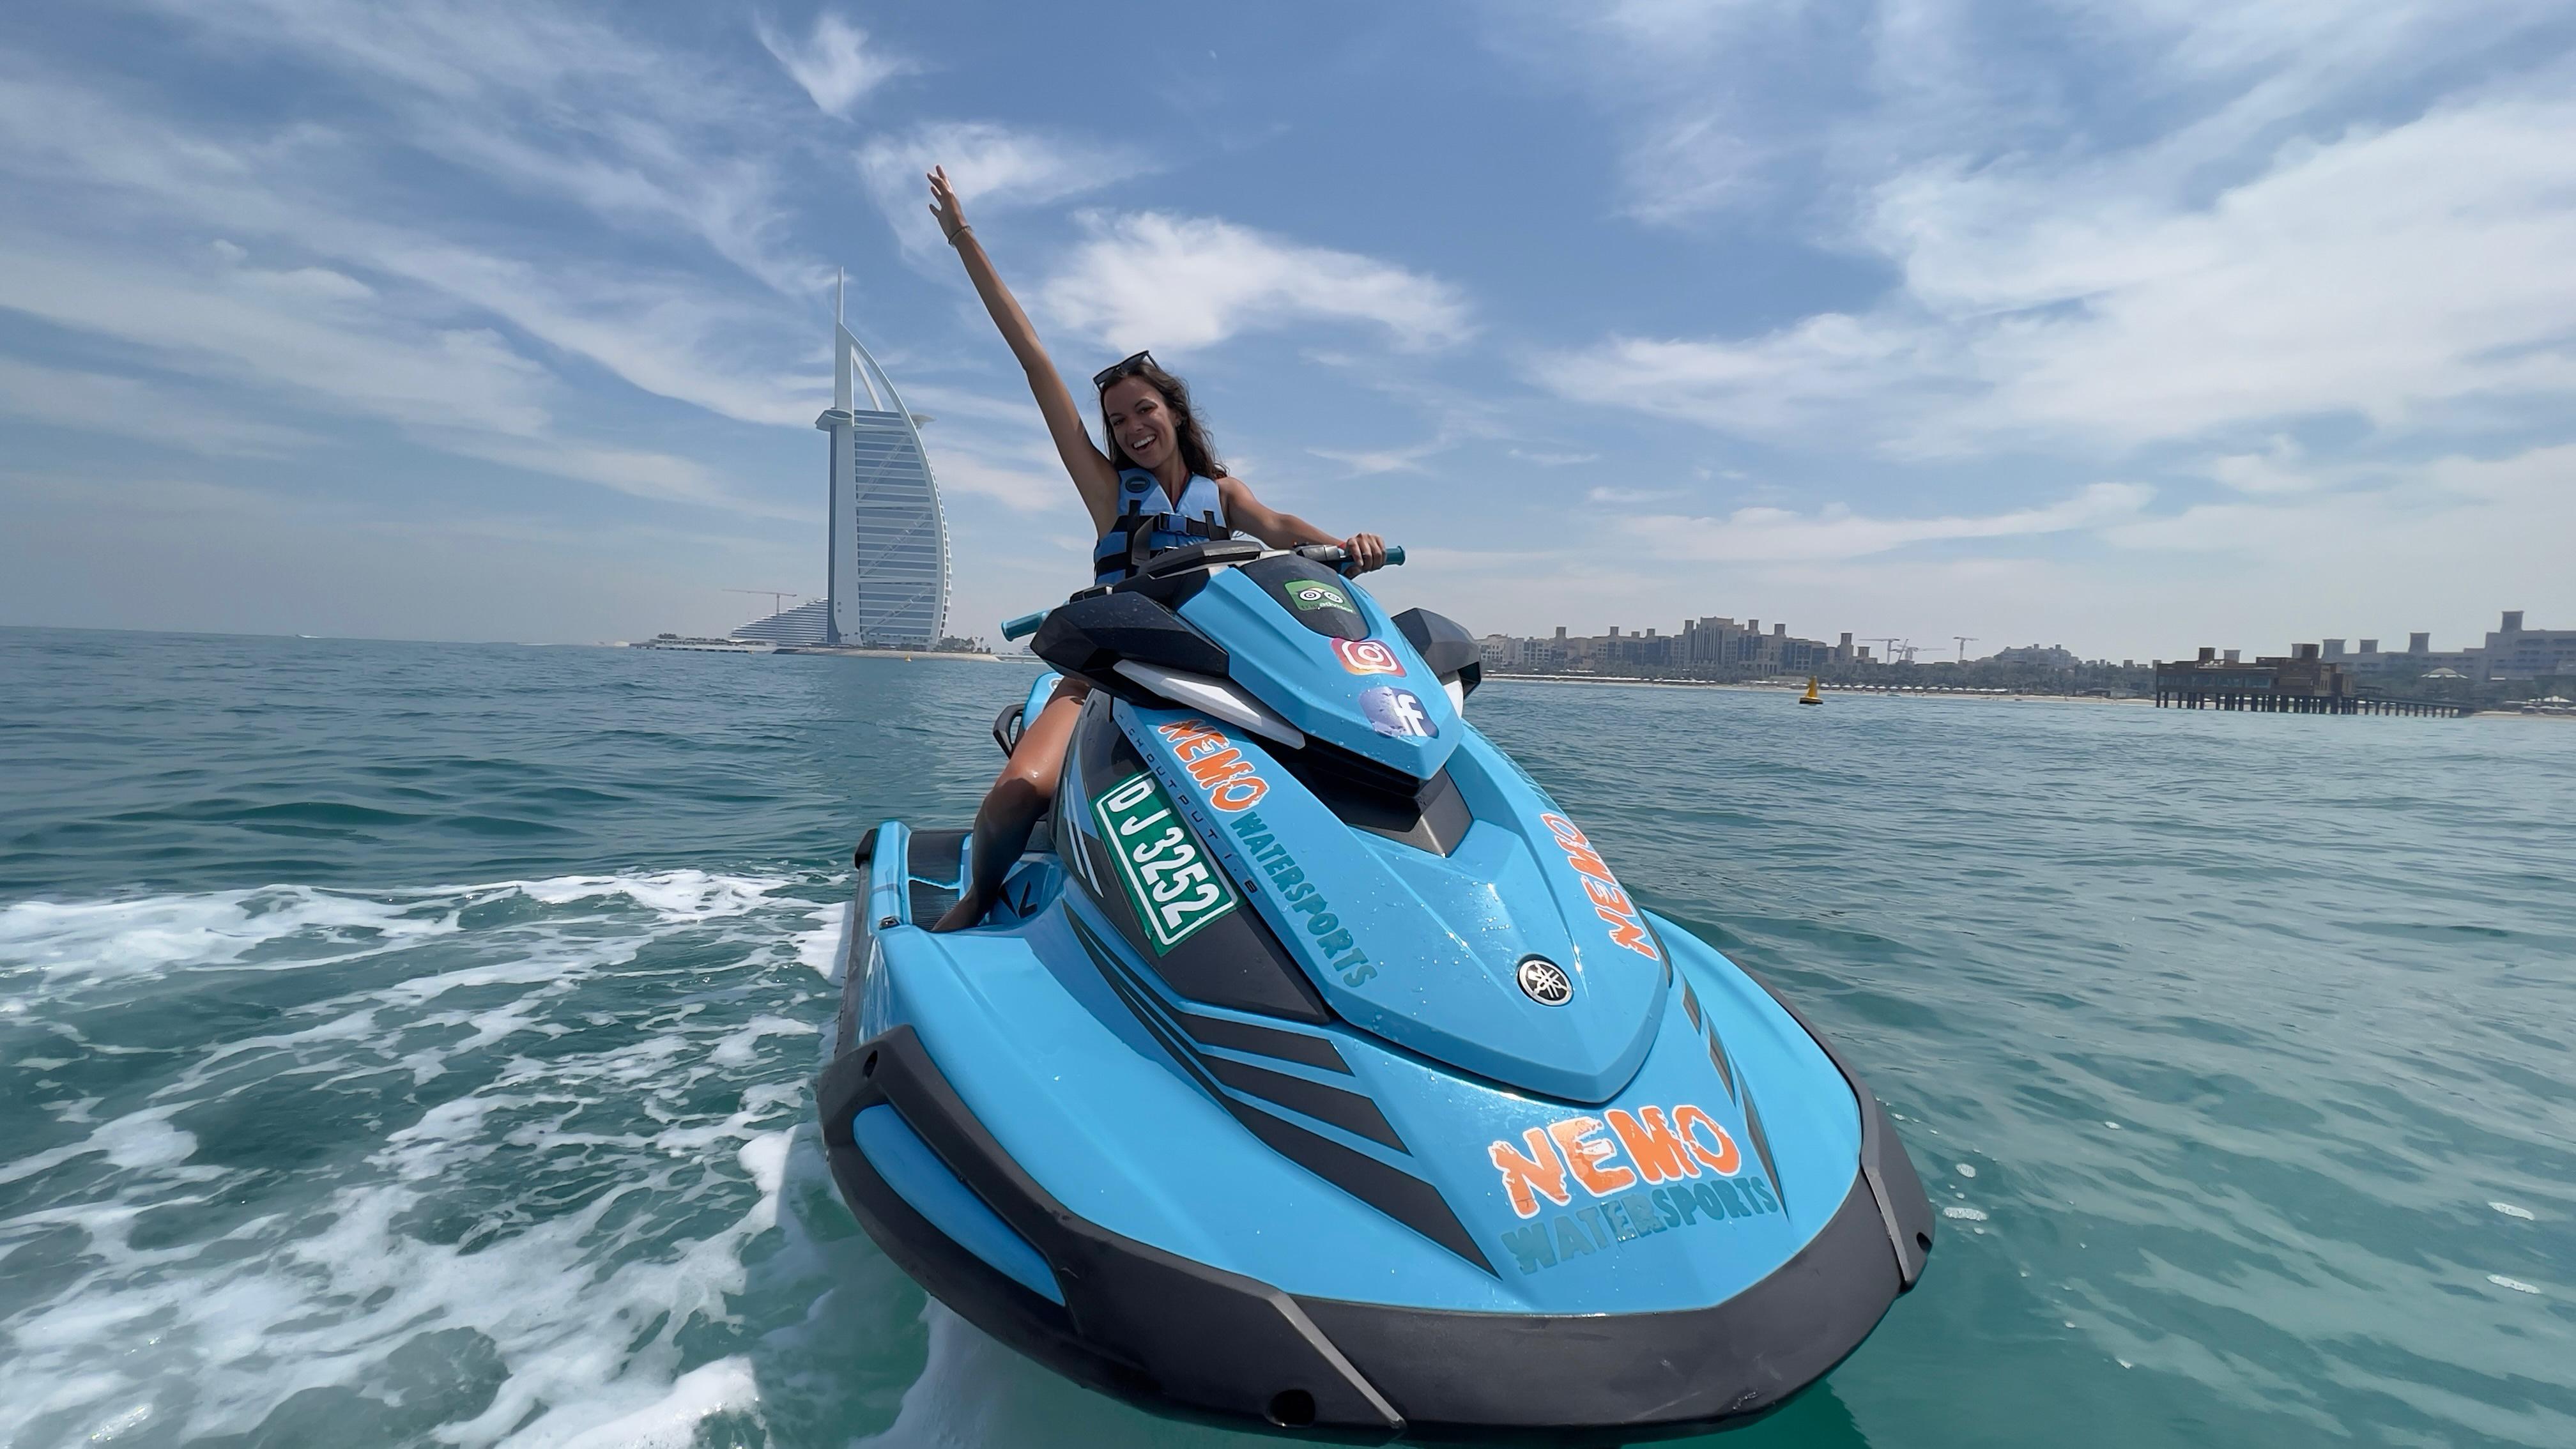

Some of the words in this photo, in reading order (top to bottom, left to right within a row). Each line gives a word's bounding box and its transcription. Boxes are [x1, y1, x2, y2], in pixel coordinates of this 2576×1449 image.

[1108, 778, 1155, 813] D
[1146, 753, 1218, 839] OUTPUT
[1158, 719, 1269, 811] NEMO
[1120, 808, 1172, 836] J
[1133, 826, 1220, 930] 3252
[1230, 811, 1378, 988] WATERSPORTS
[1540, 813, 1659, 961] NEMO
[1488, 1105, 1741, 1219] NEMO
[1500, 1176, 1779, 1275] WATERSPORTS
